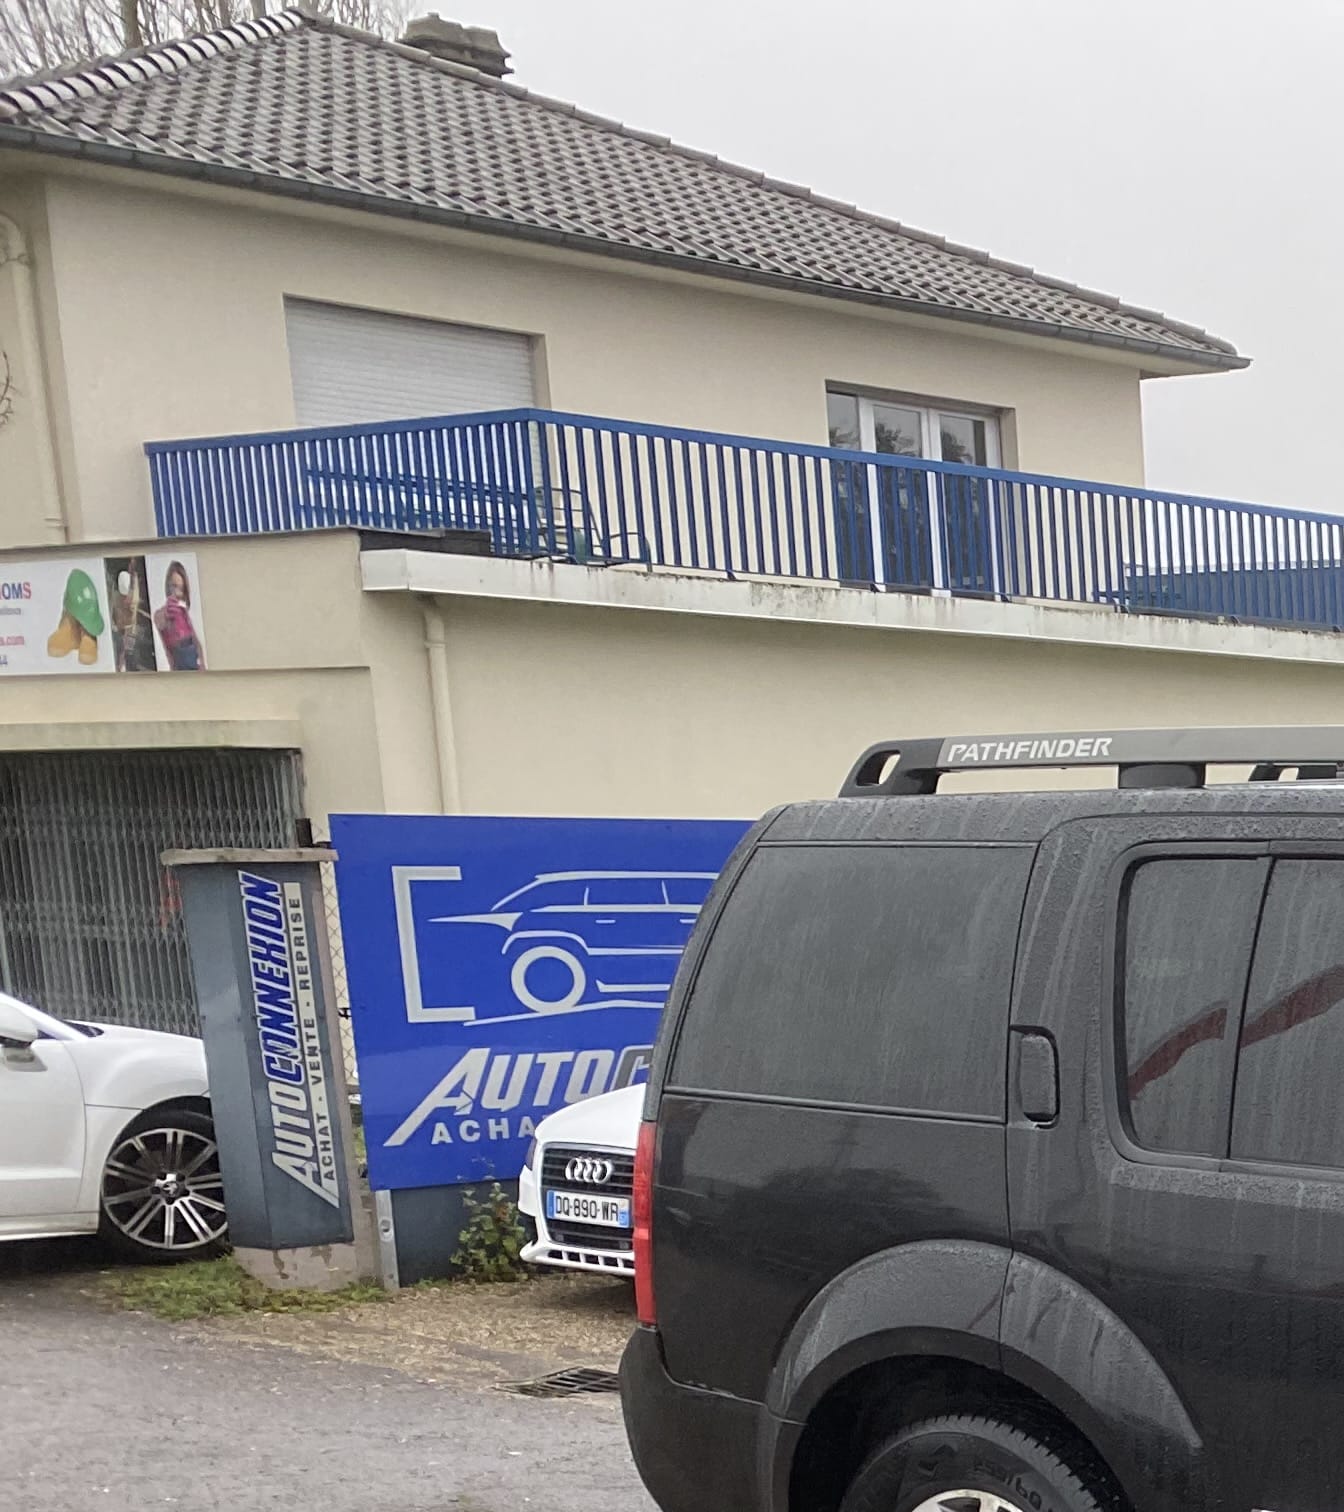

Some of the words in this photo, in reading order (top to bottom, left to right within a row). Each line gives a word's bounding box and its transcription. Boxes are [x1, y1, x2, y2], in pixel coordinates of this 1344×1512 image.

[0, 582, 31, 600] OMS
[947, 738, 1112, 762] PATHFINDER
[289, 898, 311, 990] REPRISE
[238, 870, 339, 1208] AUTOCONNEXION
[304, 1018, 322, 1086] VENTE
[316, 1113, 335, 1181] ACHAT
[431, 1115, 546, 1145] ACHA
